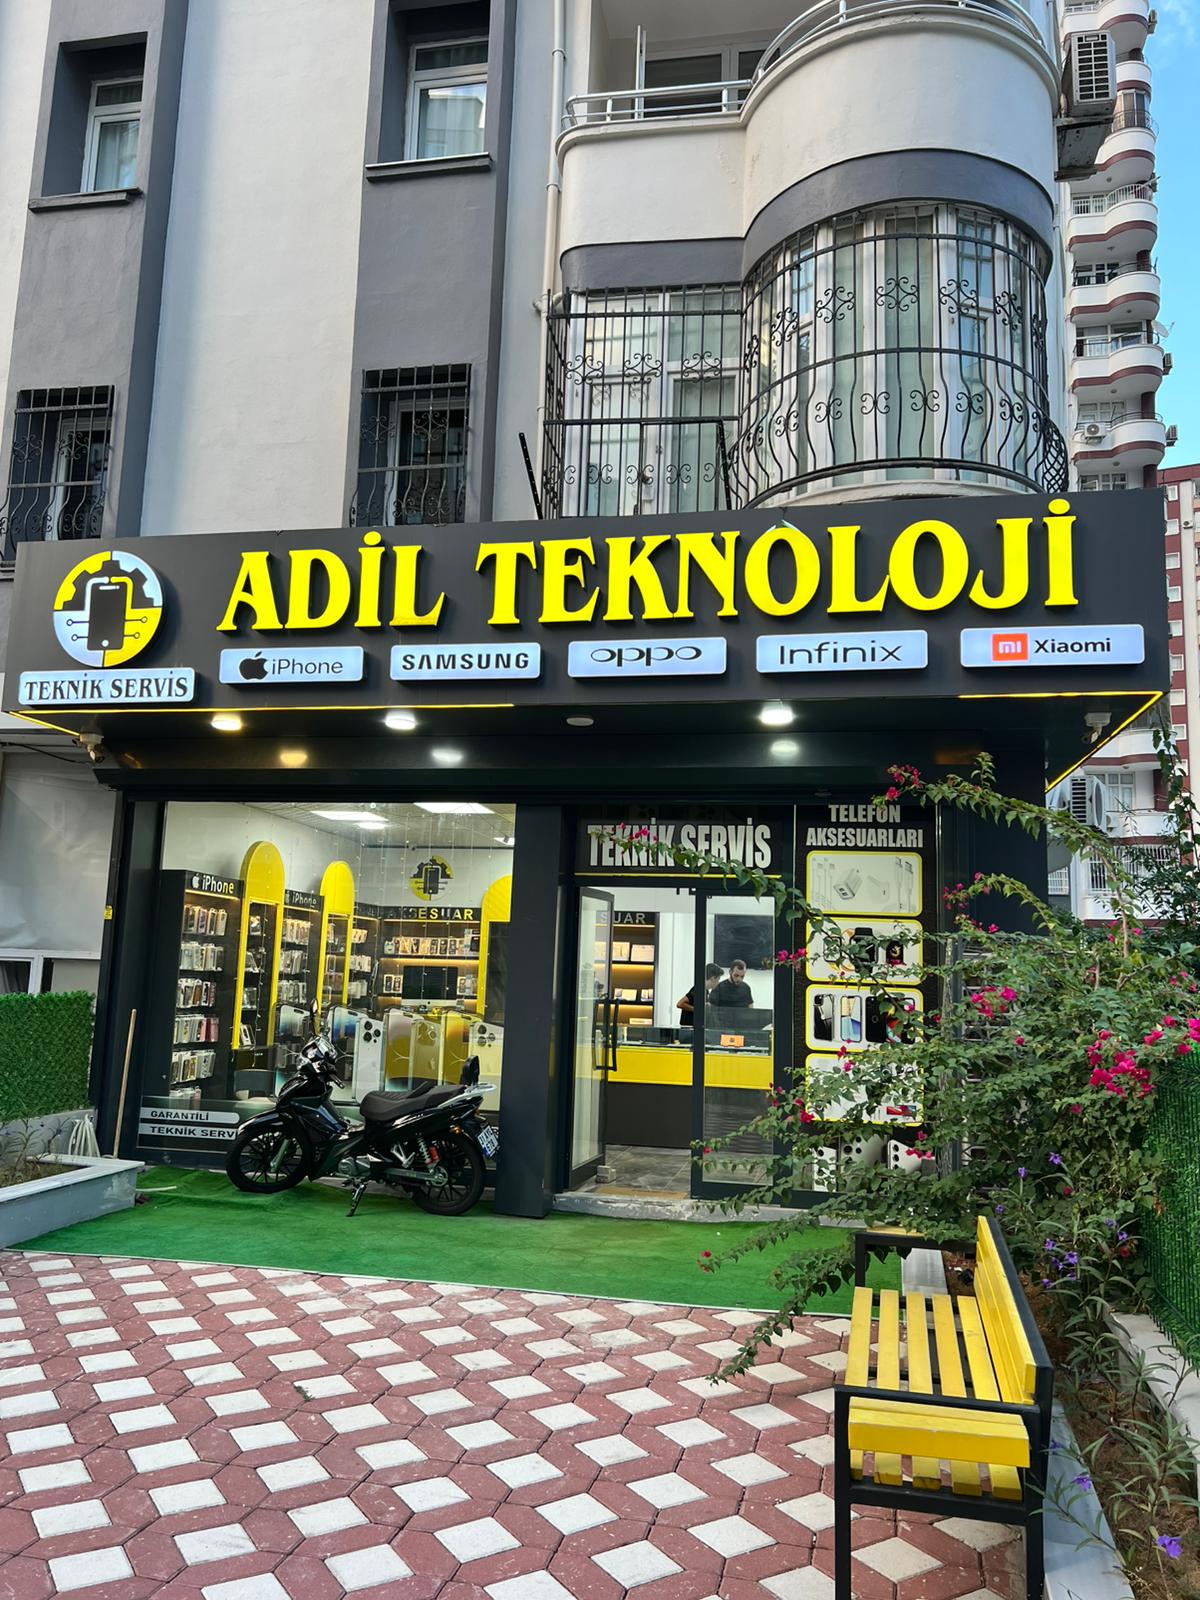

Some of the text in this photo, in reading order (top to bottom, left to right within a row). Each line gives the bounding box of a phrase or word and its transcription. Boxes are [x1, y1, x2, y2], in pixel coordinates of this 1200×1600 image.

[216, 498, 1079, 631] ADİL TEKNOLOJİ
[779, 640, 903, 665] Infinix
[1034, 637, 1112, 654] Xiaomi
[271, 658, 344, 675] iPhone
[402, 652, 529, 671] SAMSUNG
[25, 670, 188, 701] TEKNİK SERVİS
[828, 804, 901, 823] TELEFON
[587, 817, 772, 869] TEKNİK SERVİS
[806, 827, 924, 848] AKSESUARLARI
[202, 874, 235, 894] iPhone
[150, 1110, 209, 1121] GARANTİLİ
[150, 1126, 196, 1137] TEKNİK
